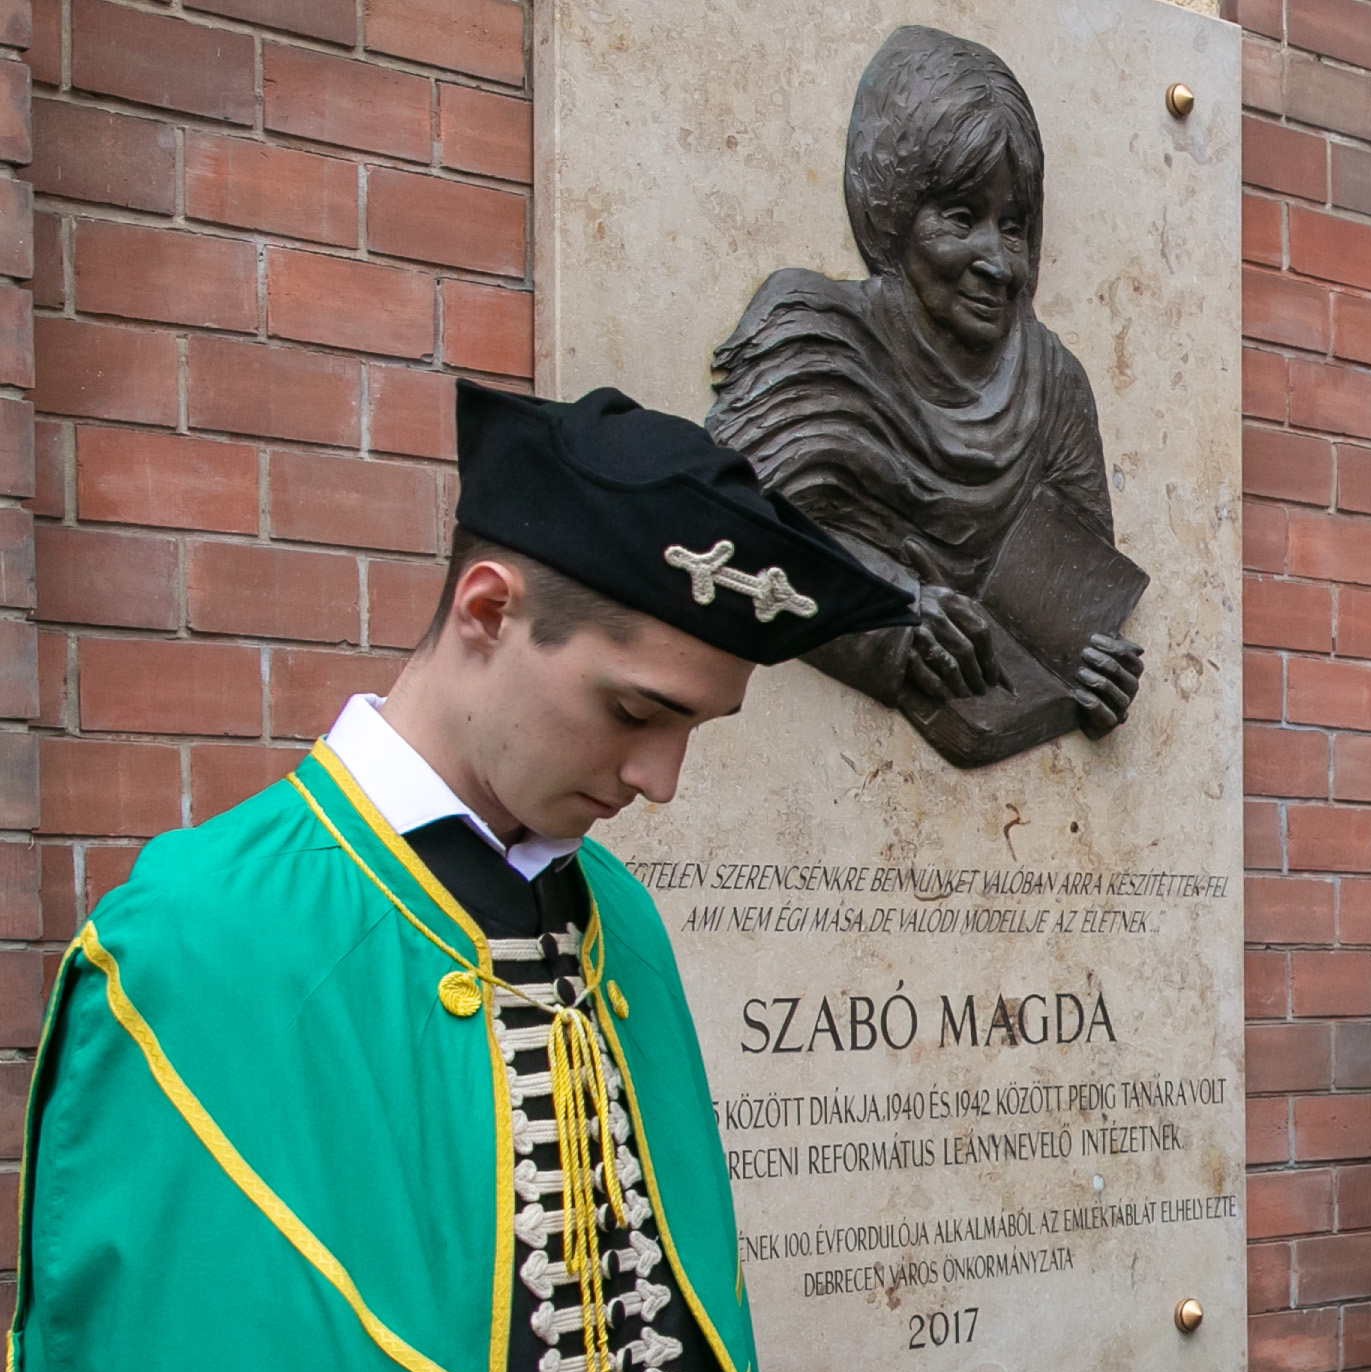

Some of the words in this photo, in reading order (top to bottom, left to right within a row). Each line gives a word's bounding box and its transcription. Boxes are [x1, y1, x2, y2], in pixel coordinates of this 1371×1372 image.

[711, 860, 869, 892] SZERENCSÉNKRE
[982, 864, 1056, 895] VALÓBAN
[1056, 872, 1102, 896] ARRA
[681, 905, 726, 932] AMI
[726, 905, 773, 932] NEM
[774, 900, 808, 932] ÉGI
[868, 908, 897, 933] DE
[898, 902, 960, 934] VALÓDI
[963, 909, 1050, 934] MODELLJE
[1051, 909, 1077, 934] AZ
[740, 980, 918, 1054] SZABÓ
[939, 991, 1117, 1048] MAGDA
[725, 1093, 804, 1131] KÖZÖTT
[886, 1092, 926, 1123] 1940
[929, 1084, 951, 1120] ÉS
[954, 1089, 990, 1118] 1942
[996, 1082, 1064, 1116] KÖZÖTT
[1068, 1083, 1116, 1112] PEDIG
[1121, 1073, 1187, 1109] TANÁRA
[1190, 1078, 1227, 1105] VOLT
[724, 1147, 798, 1181] RECENI
[808, 1132, 936, 1176] REFORMÁTUS
[943, 1122, 1073, 1167] LEÁNYNEVELŐ
[816, 1217, 930, 1256] ÉVFORDULÓJA
[933, 1206, 1036, 1246] ALKALMÁBÓL
[1038, 1209, 1059, 1234] AZ
[1063, 1196, 1157, 1232] EMLÉKTÁBLÁT
[1161, 1194, 1237, 1224] ELHELYEZTE
[804, 1266, 885, 1298] DEBRECEN
[889, 1256, 939, 1288] VÁROS
[943, 1246, 1075, 1283] ÖNKORMÁNYZATA
[908, 1306, 980, 1351] 2017
